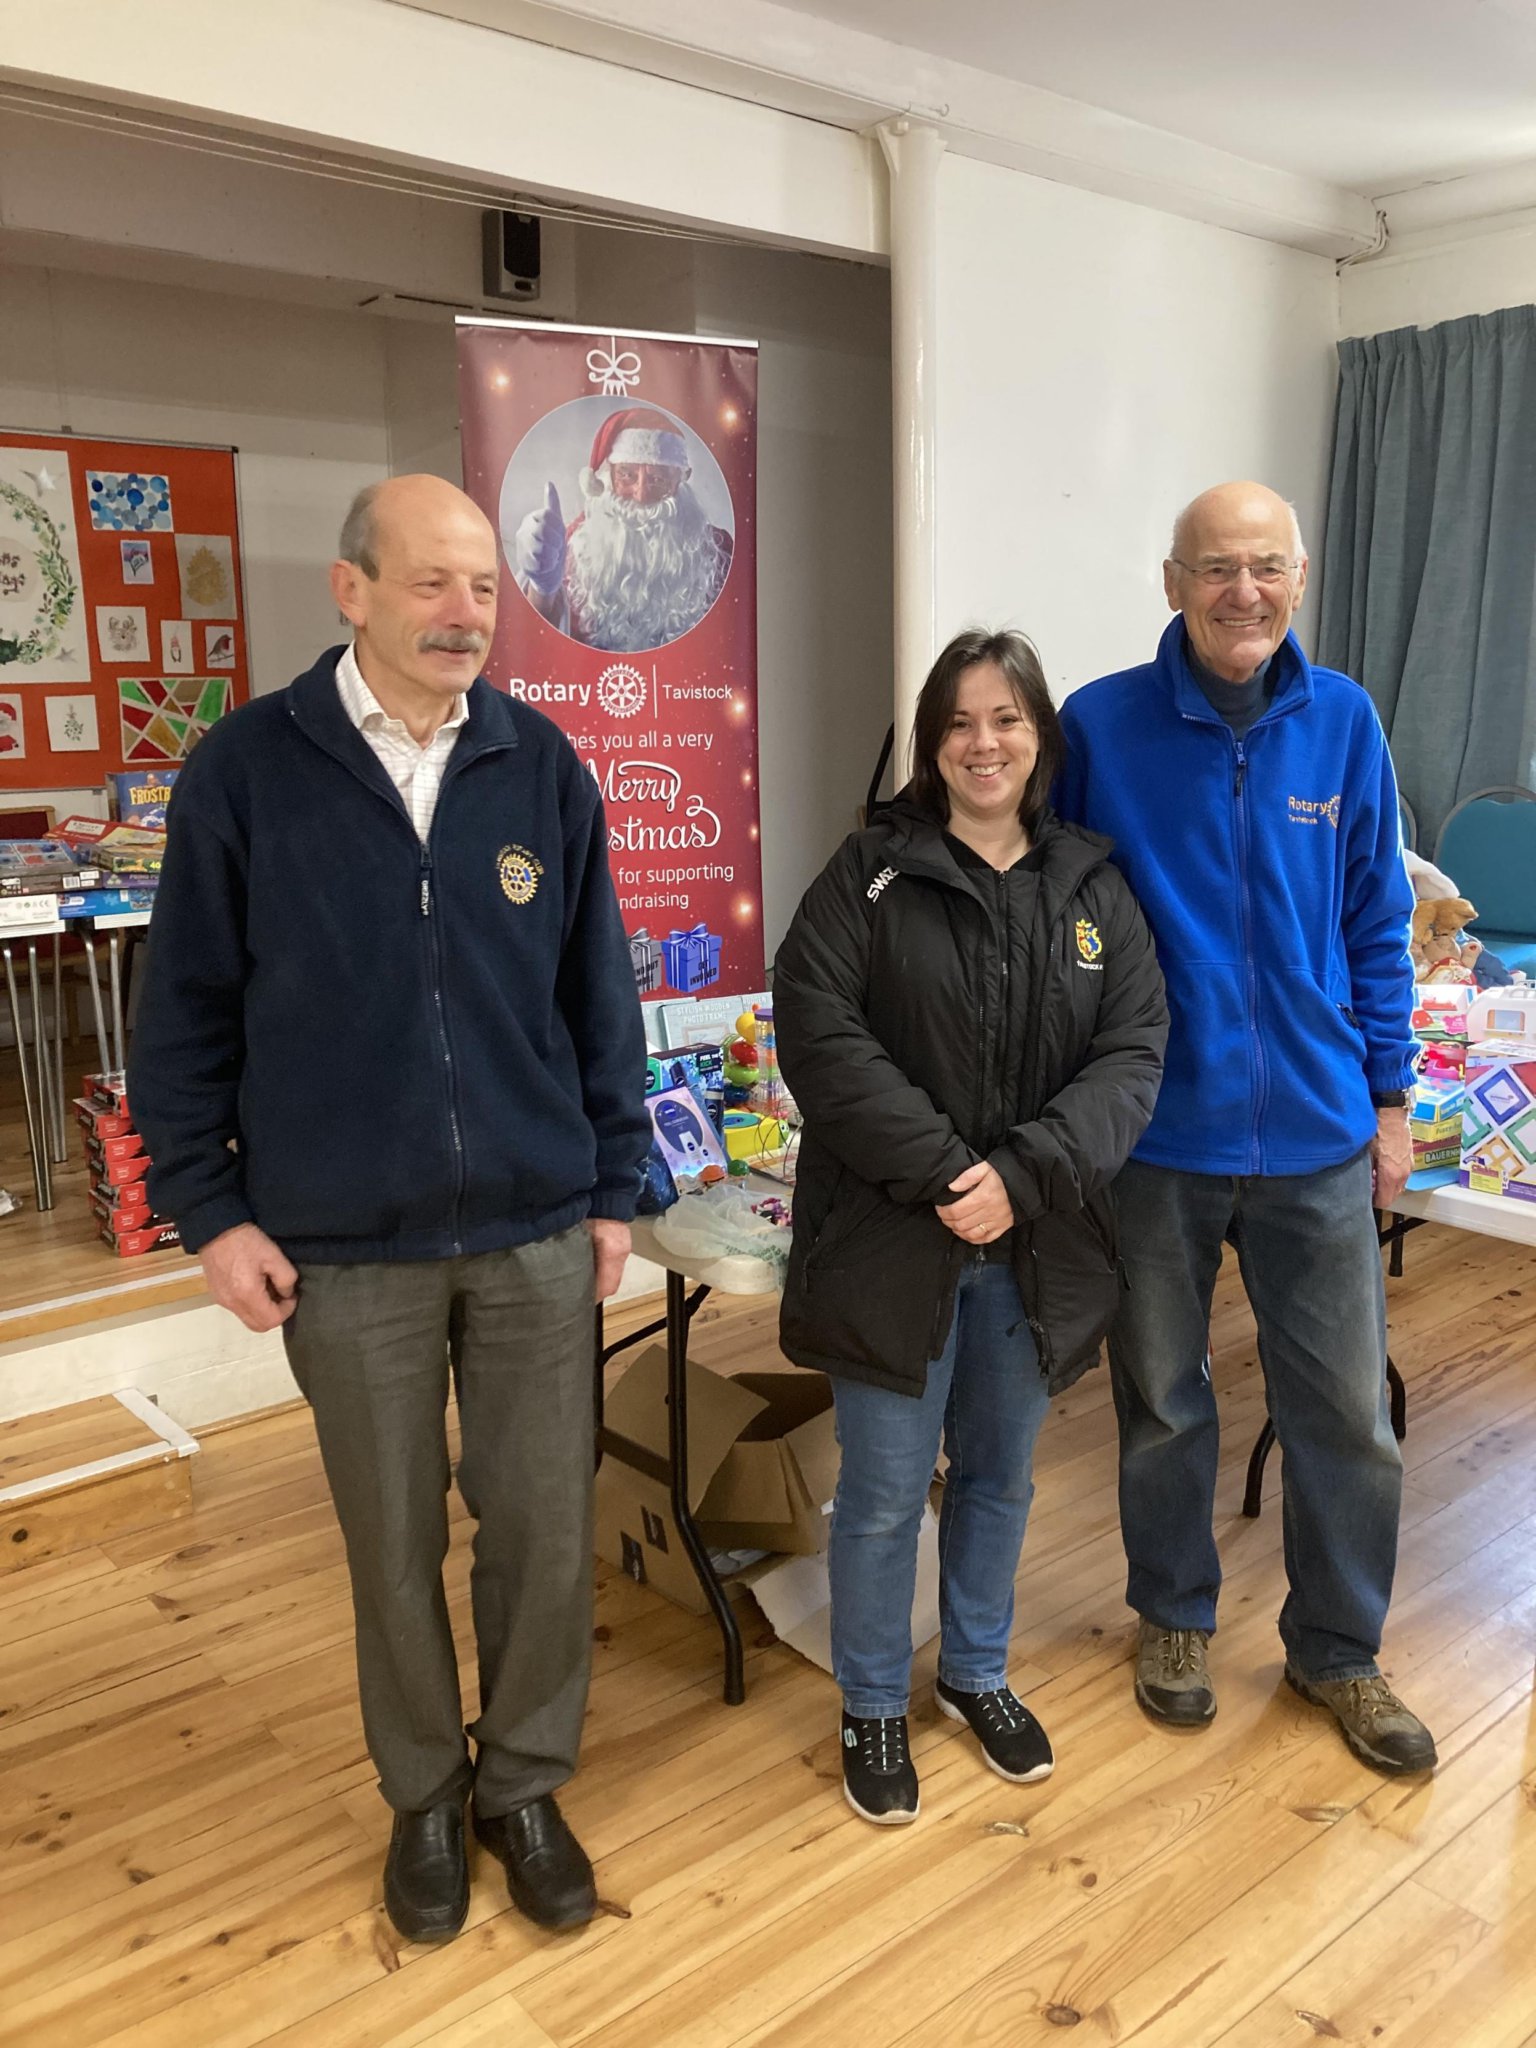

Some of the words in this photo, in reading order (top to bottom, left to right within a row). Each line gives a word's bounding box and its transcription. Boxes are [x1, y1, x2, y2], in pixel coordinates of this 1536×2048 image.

[510, 678, 591, 706] Rotary
[662, 684, 733, 700] Tavistock
[602, 735, 633, 753] you
[638, 730, 657, 748] all
[662, 735, 672, 748] a
[677, 733, 714, 750] very
[586, 758, 682, 812] Merry
[1288, 796, 1328, 815] Rotary
[617, 867, 641, 886] for
[646, 863, 734, 885] supporting
